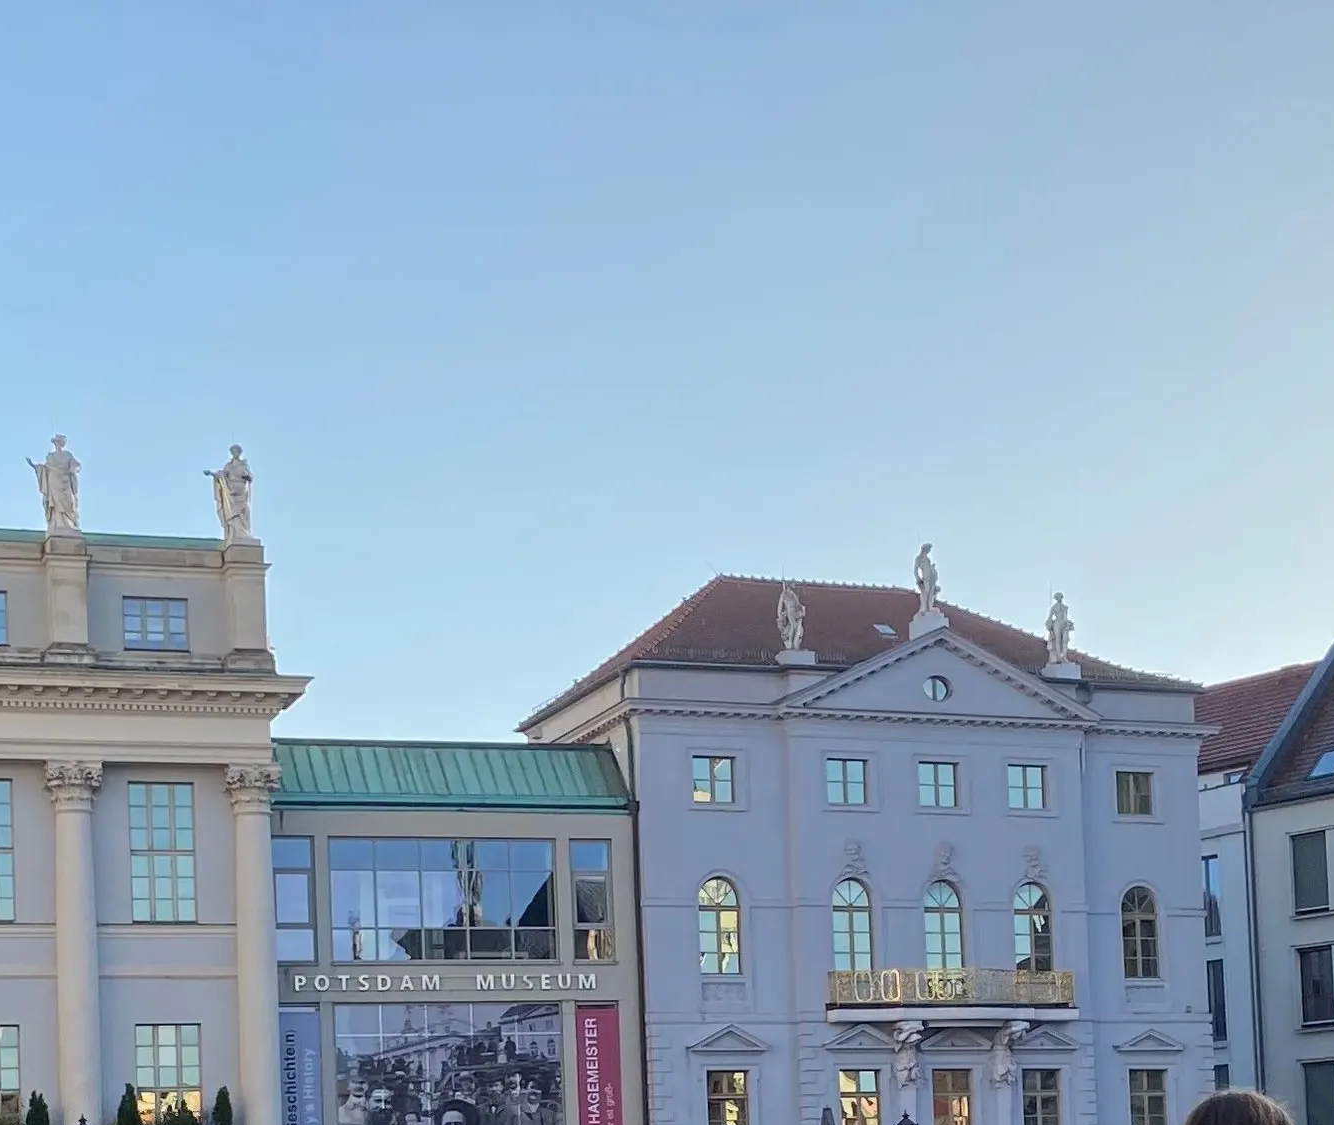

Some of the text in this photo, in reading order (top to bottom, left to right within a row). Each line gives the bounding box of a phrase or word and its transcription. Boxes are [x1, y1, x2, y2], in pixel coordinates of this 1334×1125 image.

[294, 973, 597, 992] POTSDAM MUSEUM
[302, 1048, 317, 1099] History
[584, 1018, 601, 1124] HAGEMEISTER
